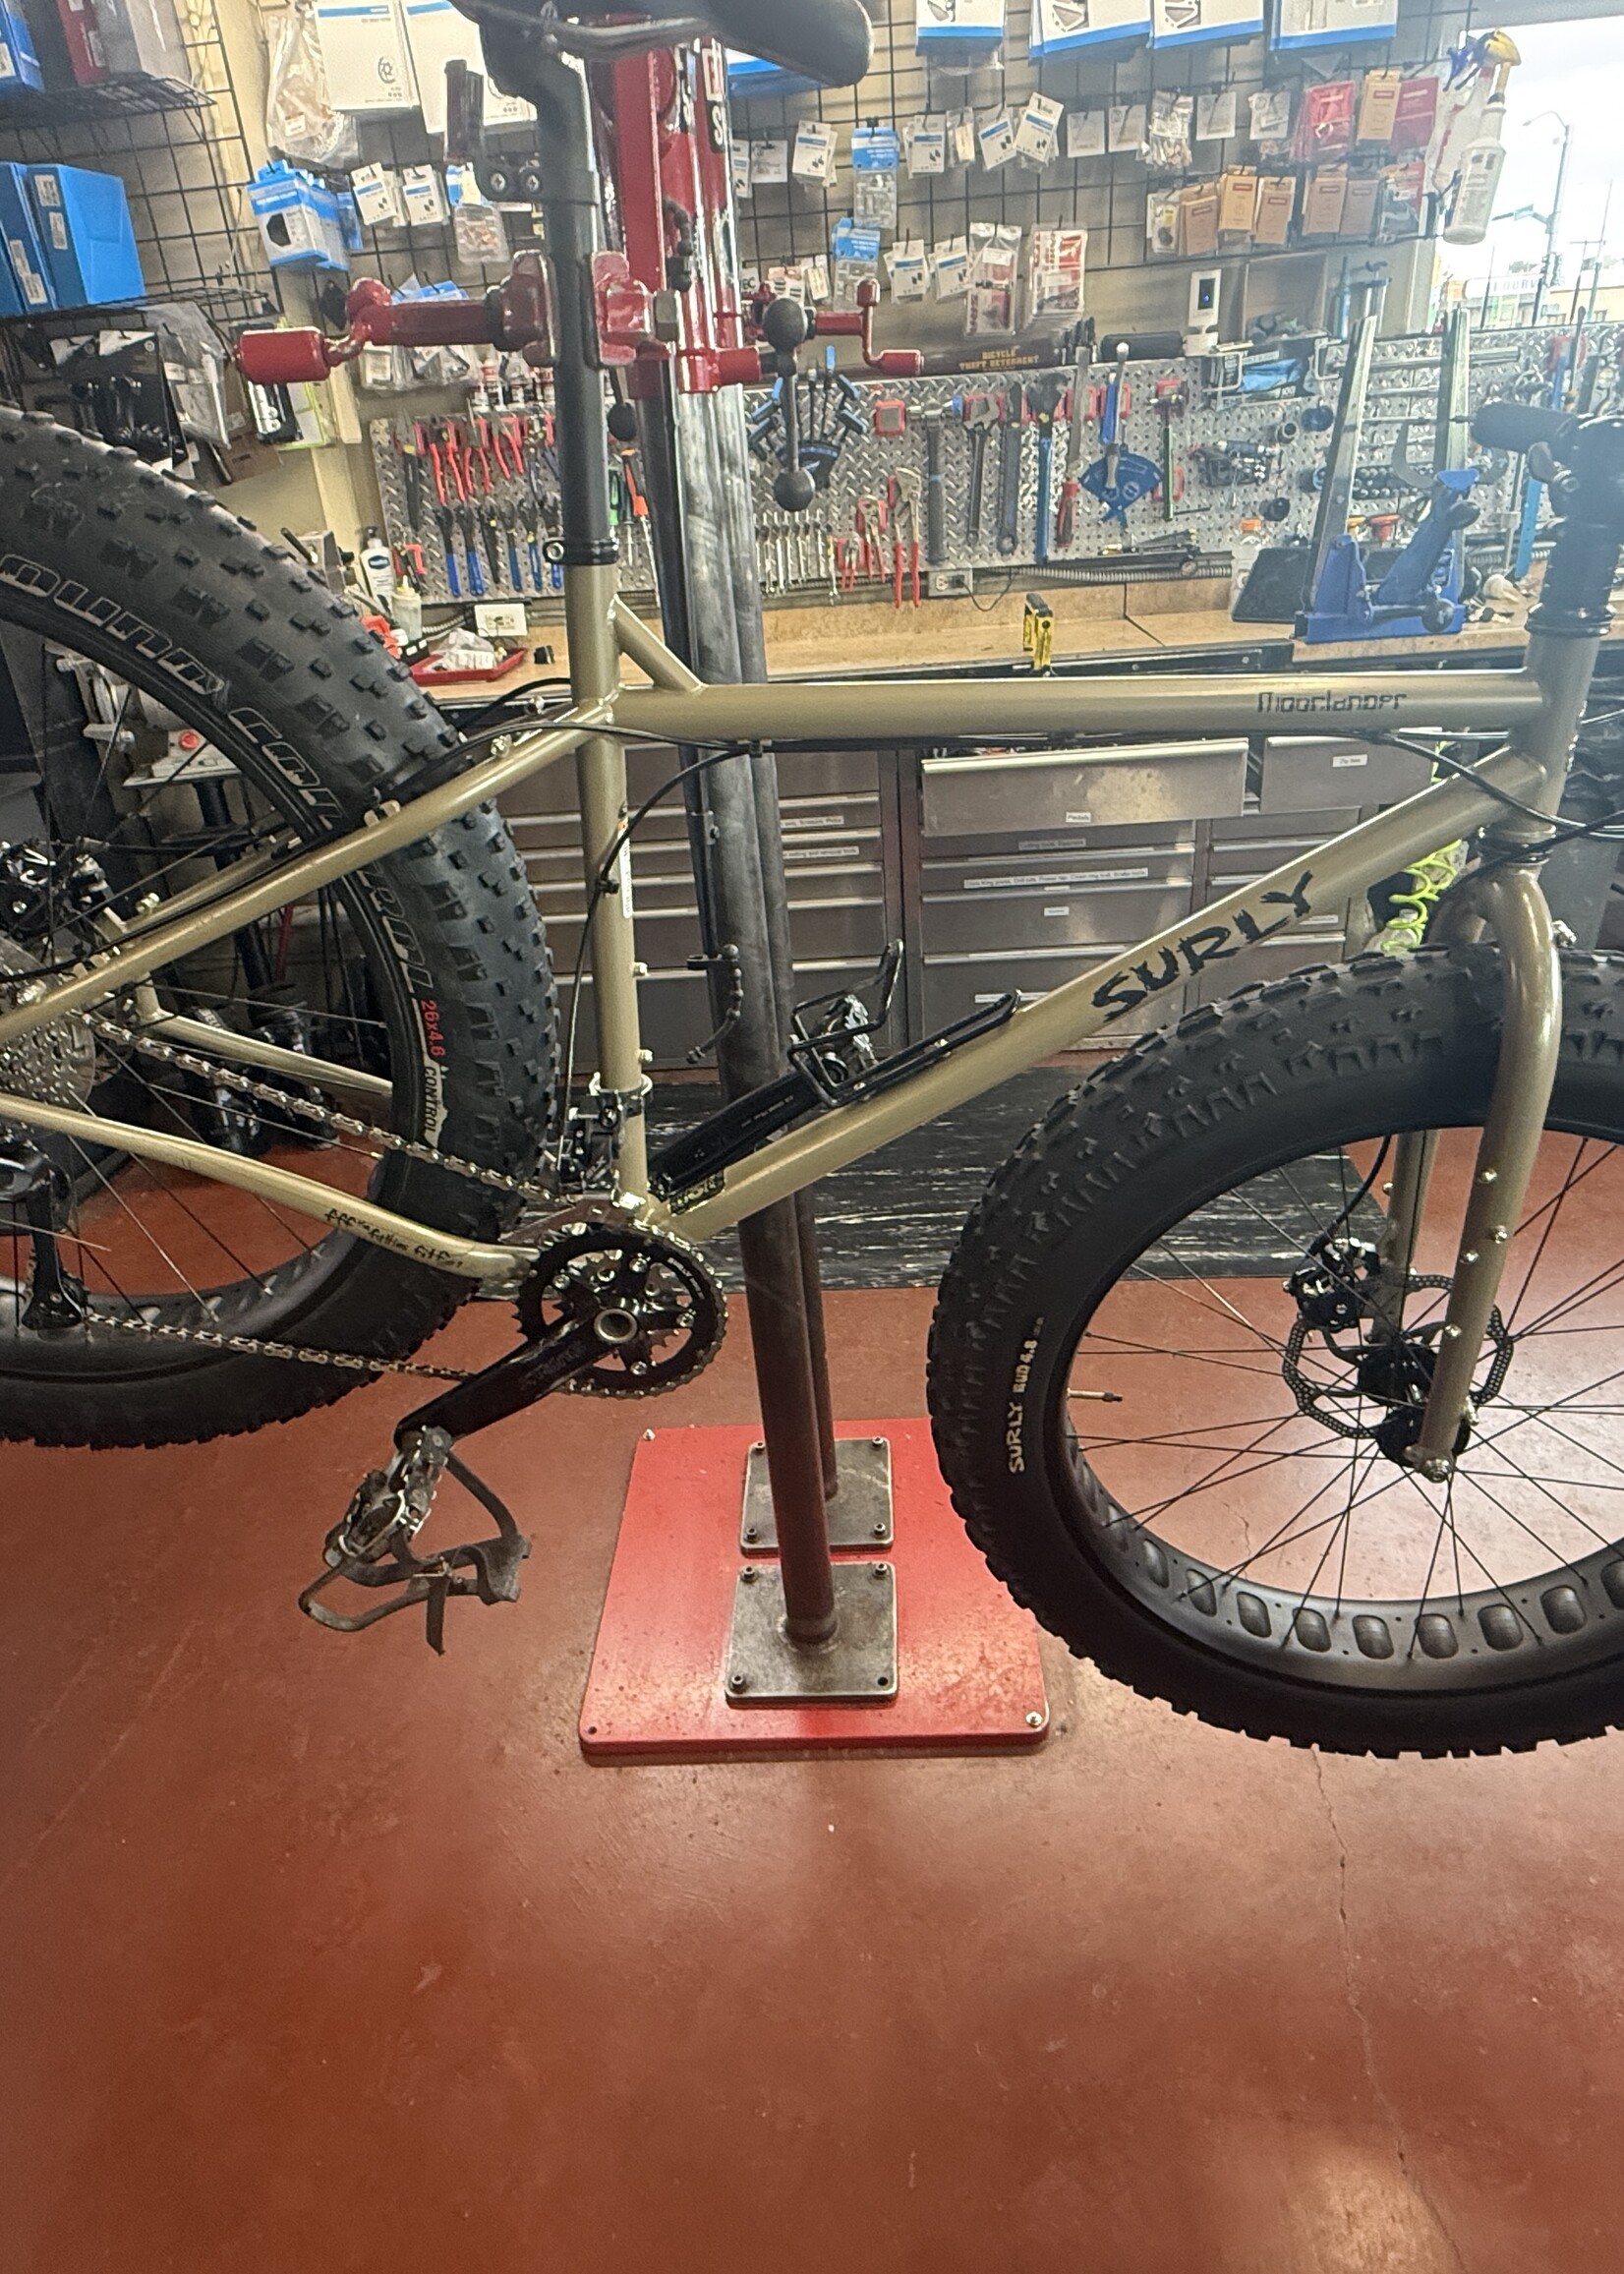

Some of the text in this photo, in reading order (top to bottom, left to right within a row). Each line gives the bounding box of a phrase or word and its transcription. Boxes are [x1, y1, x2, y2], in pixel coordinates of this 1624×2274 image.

[1091, 870, 1313, 1022] SURLY
[423, 1065, 437, 1132] CONTROL
[1006, 1401, 1025, 1473] SURLY
